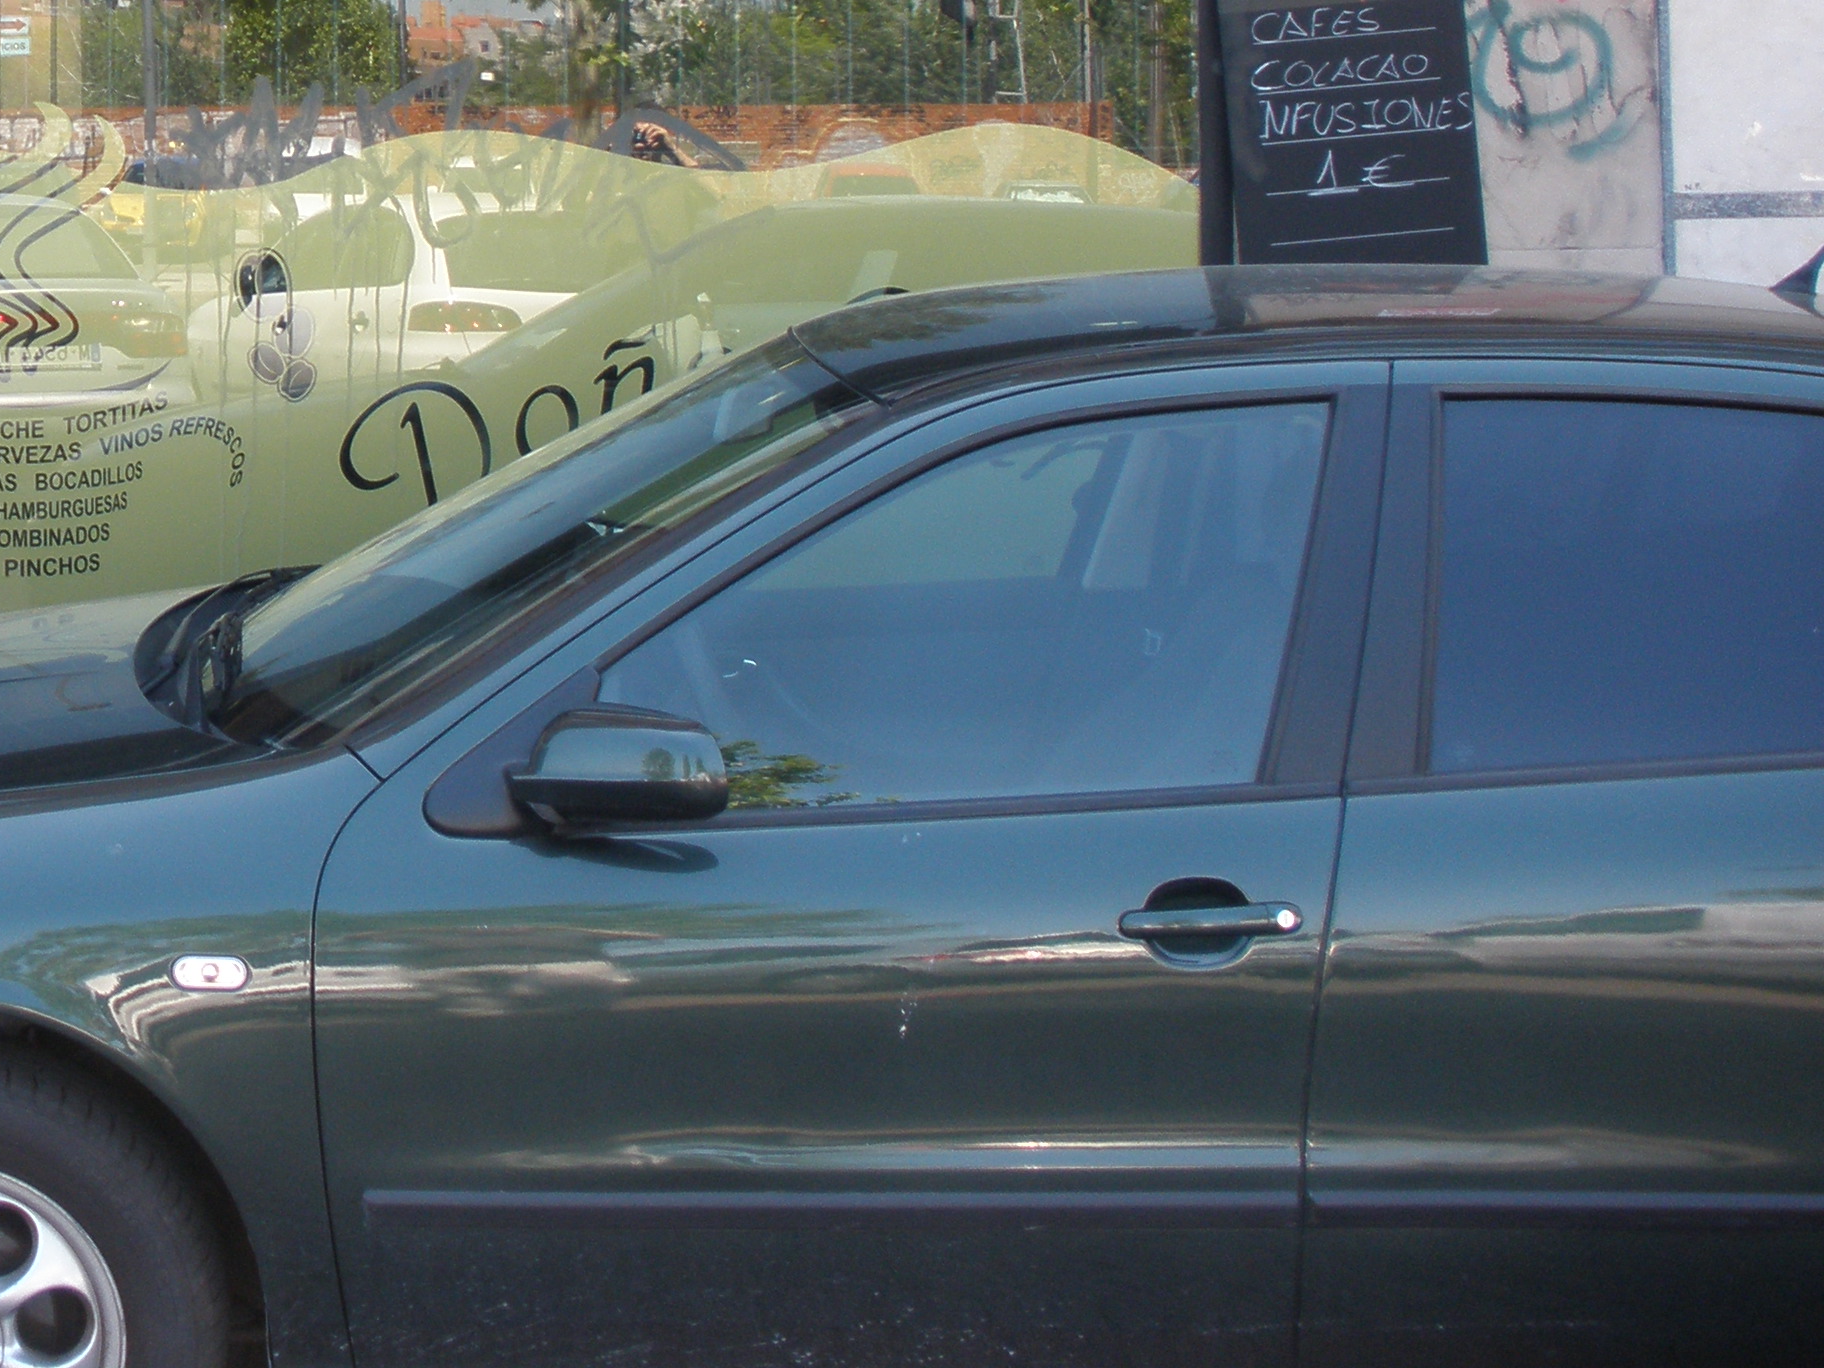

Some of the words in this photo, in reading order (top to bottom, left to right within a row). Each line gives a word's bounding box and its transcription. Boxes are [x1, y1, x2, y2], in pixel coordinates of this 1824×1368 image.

[1251, 7, 1380, 44] CAFES
[63, 390, 169, 435] TORTITAS
[339, 336, 656, 507] Doñ
[99, 421, 164, 457] VINOS
[168, 415, 247, 489] REFRESCOS
[35, 460, 144, 492] BOCADILLOS
[4, 552, 101, 578] PINCHOS
